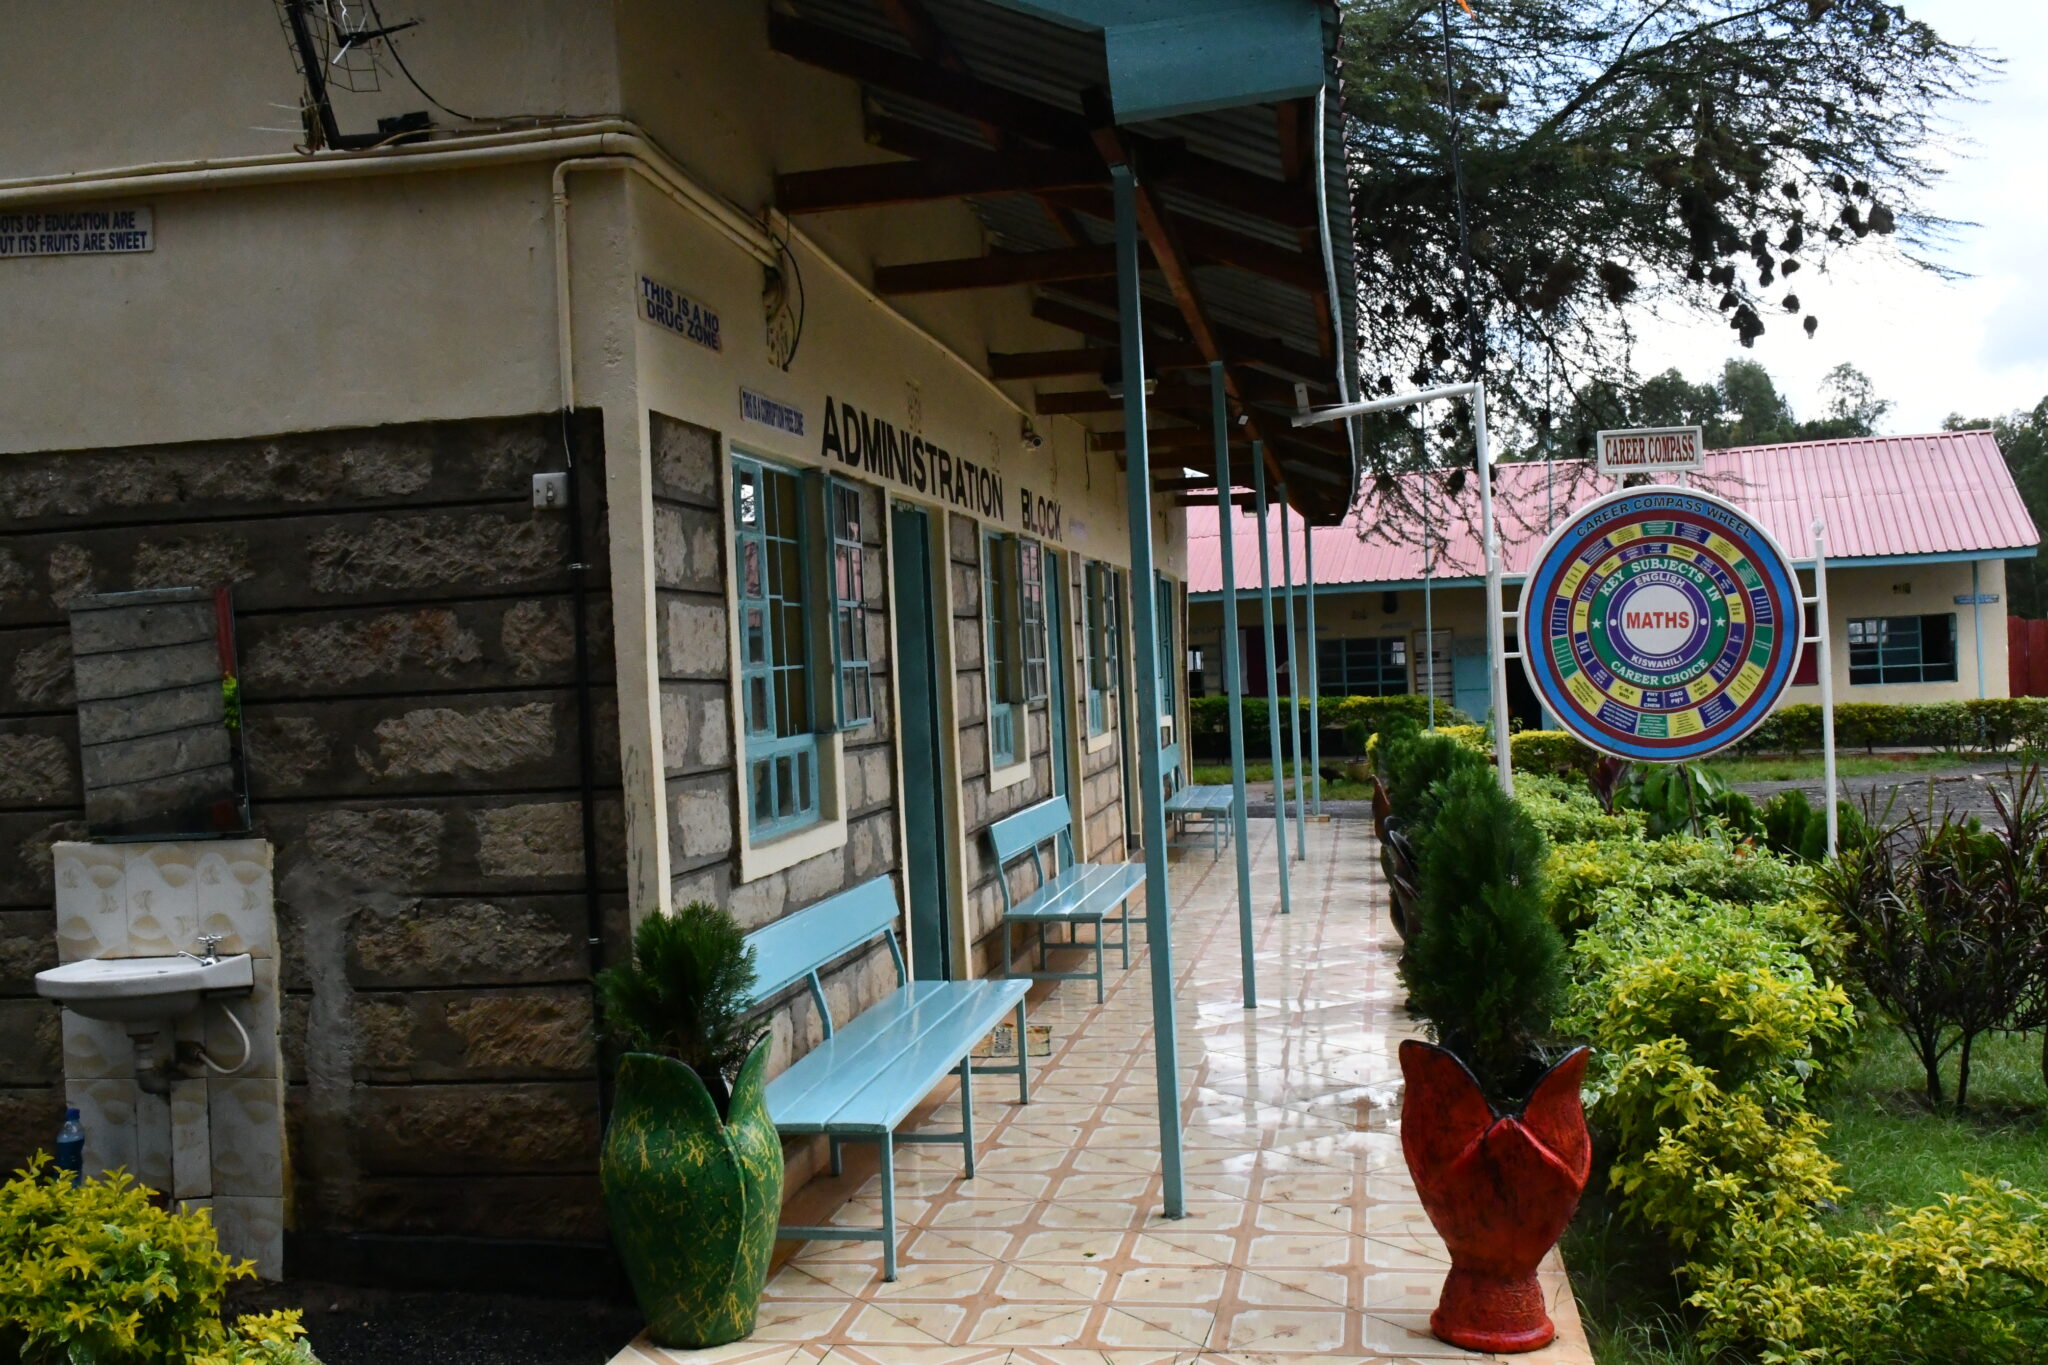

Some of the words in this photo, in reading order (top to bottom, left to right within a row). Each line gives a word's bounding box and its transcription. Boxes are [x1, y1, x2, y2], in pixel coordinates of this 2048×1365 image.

[0, 215, 23, 233] OTS
[26, 214, 41, 232] OF
[45, 212, 109, 232] EDUCATION
[113, 211, 136, 230] ARE
[18, 235, 36, 253] ITS
[39, 233, 80, 252] FRUITS
[83, 232, 105, 251] ARE
[109, 231, 147, 250] SWEET
[642, 276, 674, 309] THIS
[677, 295, 689, 317] IS
[693, 304, 701, 324] A
[704, 309, 719, 333] NO
[647, 299, 684, 333] DRUG
[687, 319, 719, 351] ZONE
[1605, 437, 1646, 465] CAREER
[1648, 434, 1695, 463] COMPASS
[821, 395, 1004, 521] ADMINISTRATION
[1021, 487, 1063, 542] BLOCK
[1576, 503, 1629, 537] CAREER
[1634, 497, 1702, 513] COMPASS
[1707, 506, 1751, 539] WHEEL
[1599, 571, 1625, 597] KEY
[1631, 557, 1705, 584] SUBJECTS
[1706, 584, 1722, 602] IN
[1634, 571, 1685, 587] ENGLISH
[1626, 611, 1690, 629] MATHS
[1611, 661, 1659, 686] CAREER
[1662, 658, 1709, 685] CHOICE
[1631, 654, 1683, 669] KISWAHILI
